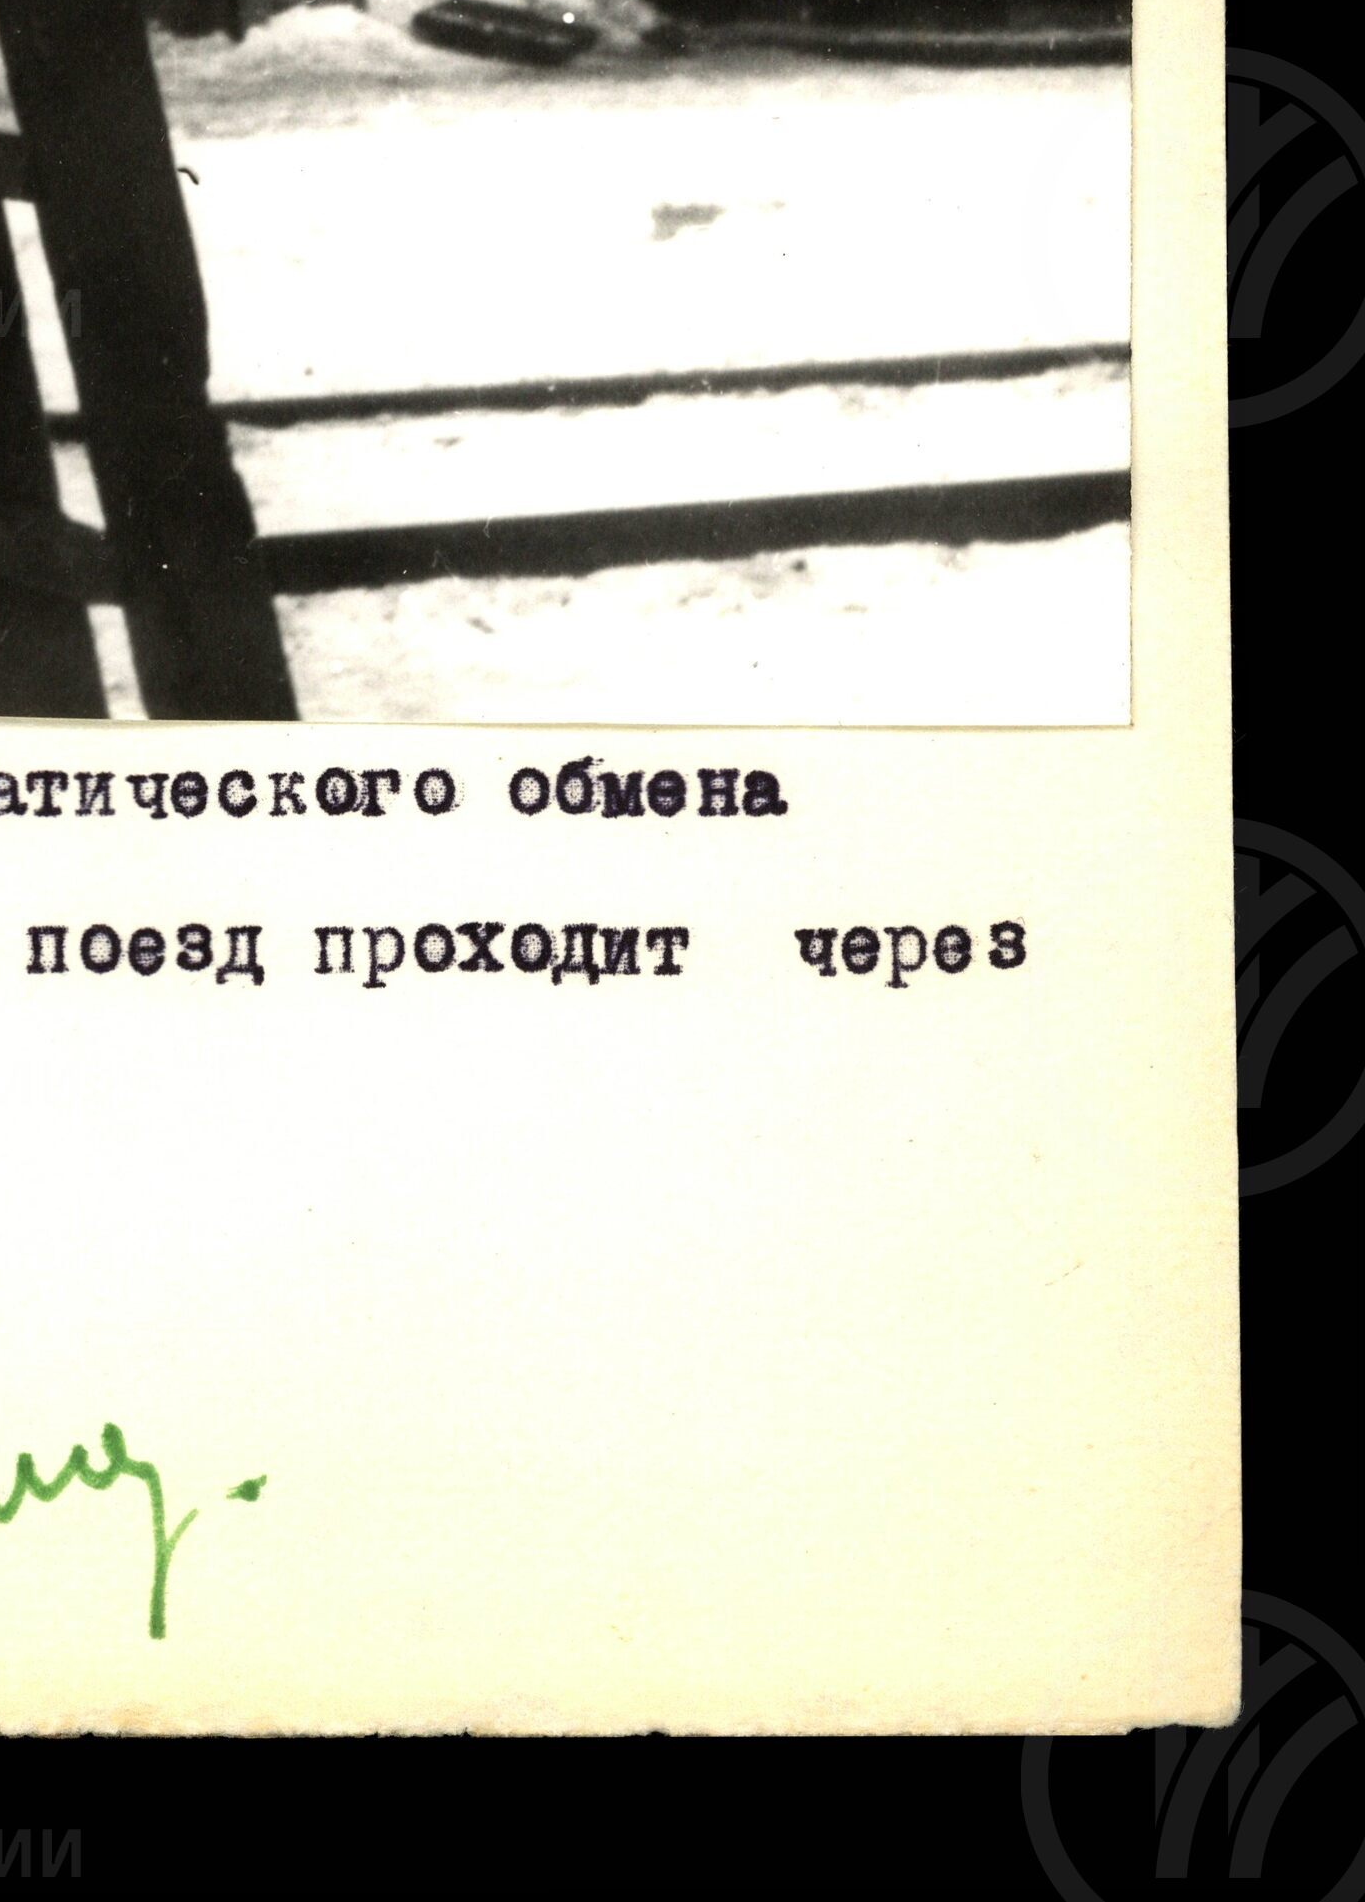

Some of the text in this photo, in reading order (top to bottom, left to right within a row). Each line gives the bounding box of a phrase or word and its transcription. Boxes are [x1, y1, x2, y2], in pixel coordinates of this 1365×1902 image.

[507, 755, 789, 819] обмена
[25, 922, 265, 986] поезд
[313, 920, 691, 989] проходит
[793, 919, 1028, 989] через
